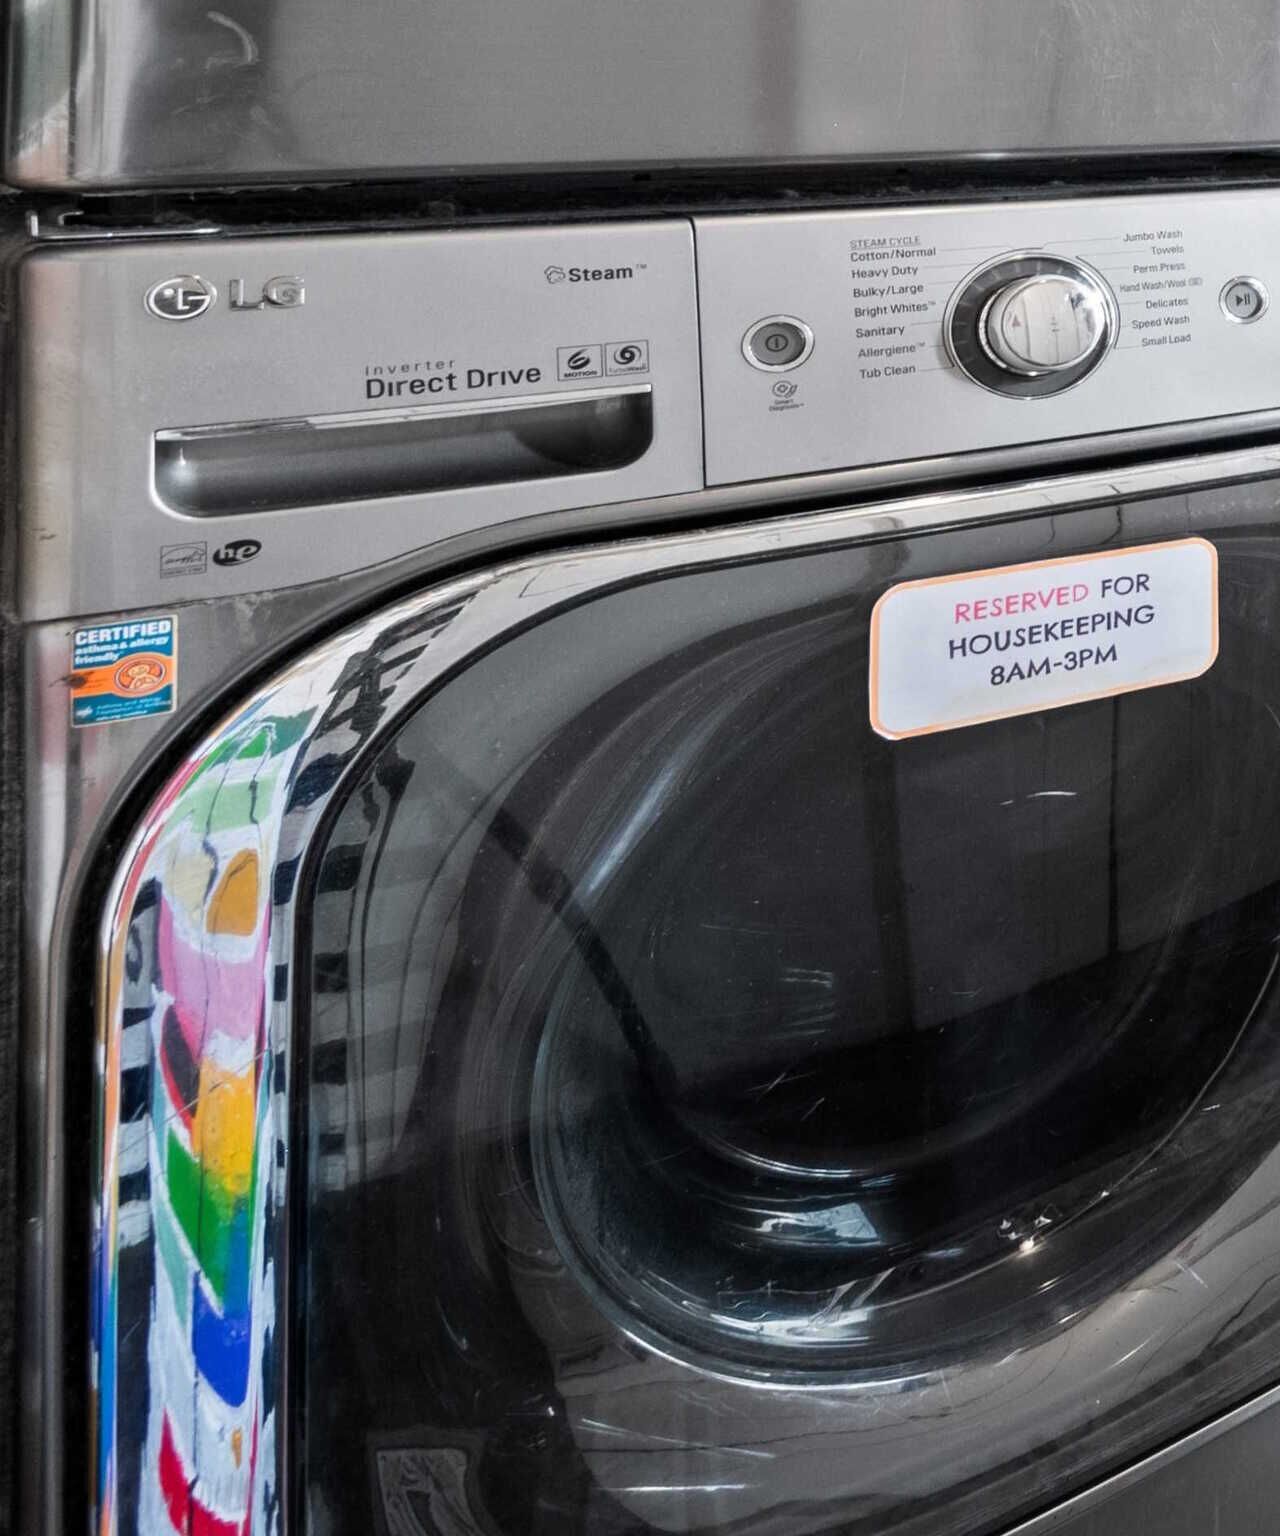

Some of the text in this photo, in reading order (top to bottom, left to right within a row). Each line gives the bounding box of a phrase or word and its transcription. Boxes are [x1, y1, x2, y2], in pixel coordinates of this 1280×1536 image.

[1123, 229, 1183, 242] Jumbo Wash
[850, 247, 937, 262] Cotton/Normal
[1151, 245, 1185, 256] Towels
[851, 265, 919, 280] Heavy Duty
[228, 275, 306, 312] LG
[853, 284, 924, 298] Bulky/Large
[1145, 297, 1189, 309] Delicates
[854, 306, 888, 318] Bright
[1131, 315, 1191, 330] Speed Wash
[855, 326, 905, 339] Sanitary
[1141, 333, 1192, 347] Small Load
[860, 364, 916, 379] Tub Clean
[366, 366, 542, 399] Direct Drive
[954, 573, 1151, 624] RESERVED FOR
[75, 619, 172, 645] CERTIFIED
[948, 604, 1156, 659] HOUSEKEEPING
[989, 644, 1118, 686] 8AM-3PM
